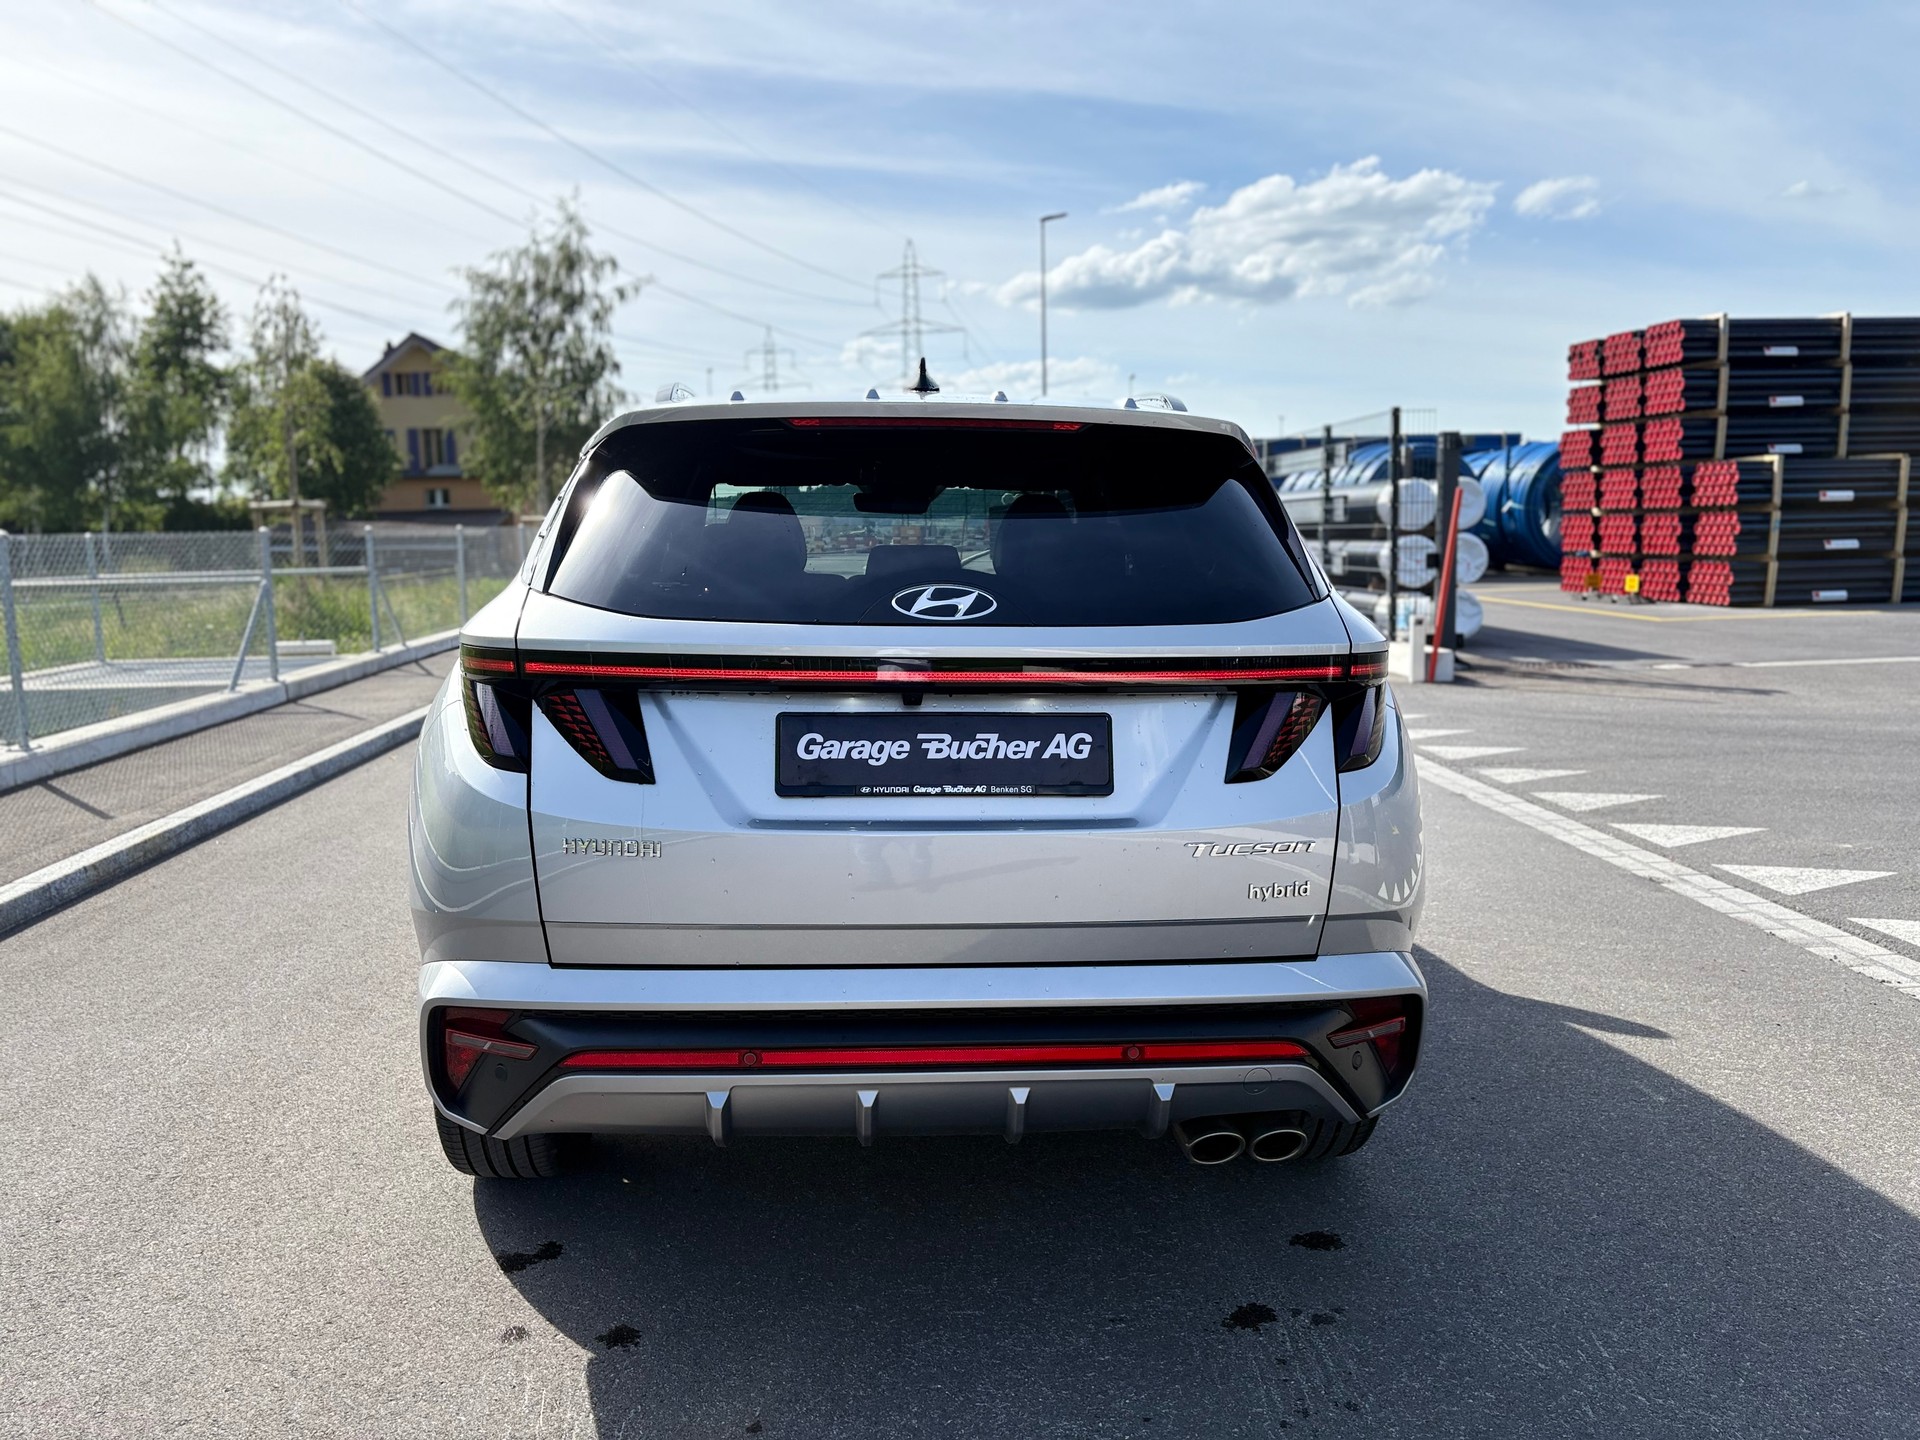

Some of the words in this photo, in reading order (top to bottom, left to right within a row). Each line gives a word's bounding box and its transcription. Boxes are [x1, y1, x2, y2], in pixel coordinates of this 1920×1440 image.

[796, 732, 911, 766] Garage
[916, 733, 1041, 760] Bucher
[1041, 733, 1093, 760] AG
[913, 785, 942, 794] Garage
[943, 785, 974, 793] Bucher
[973, 785, 987, 793] AG
[990, 785, 1019, 793] Benken
[1020, 785, 1032, 793] SG
[562, 837, 662, 858] HYUNDAI
[1248, 880, 1311, 902] hybrid
